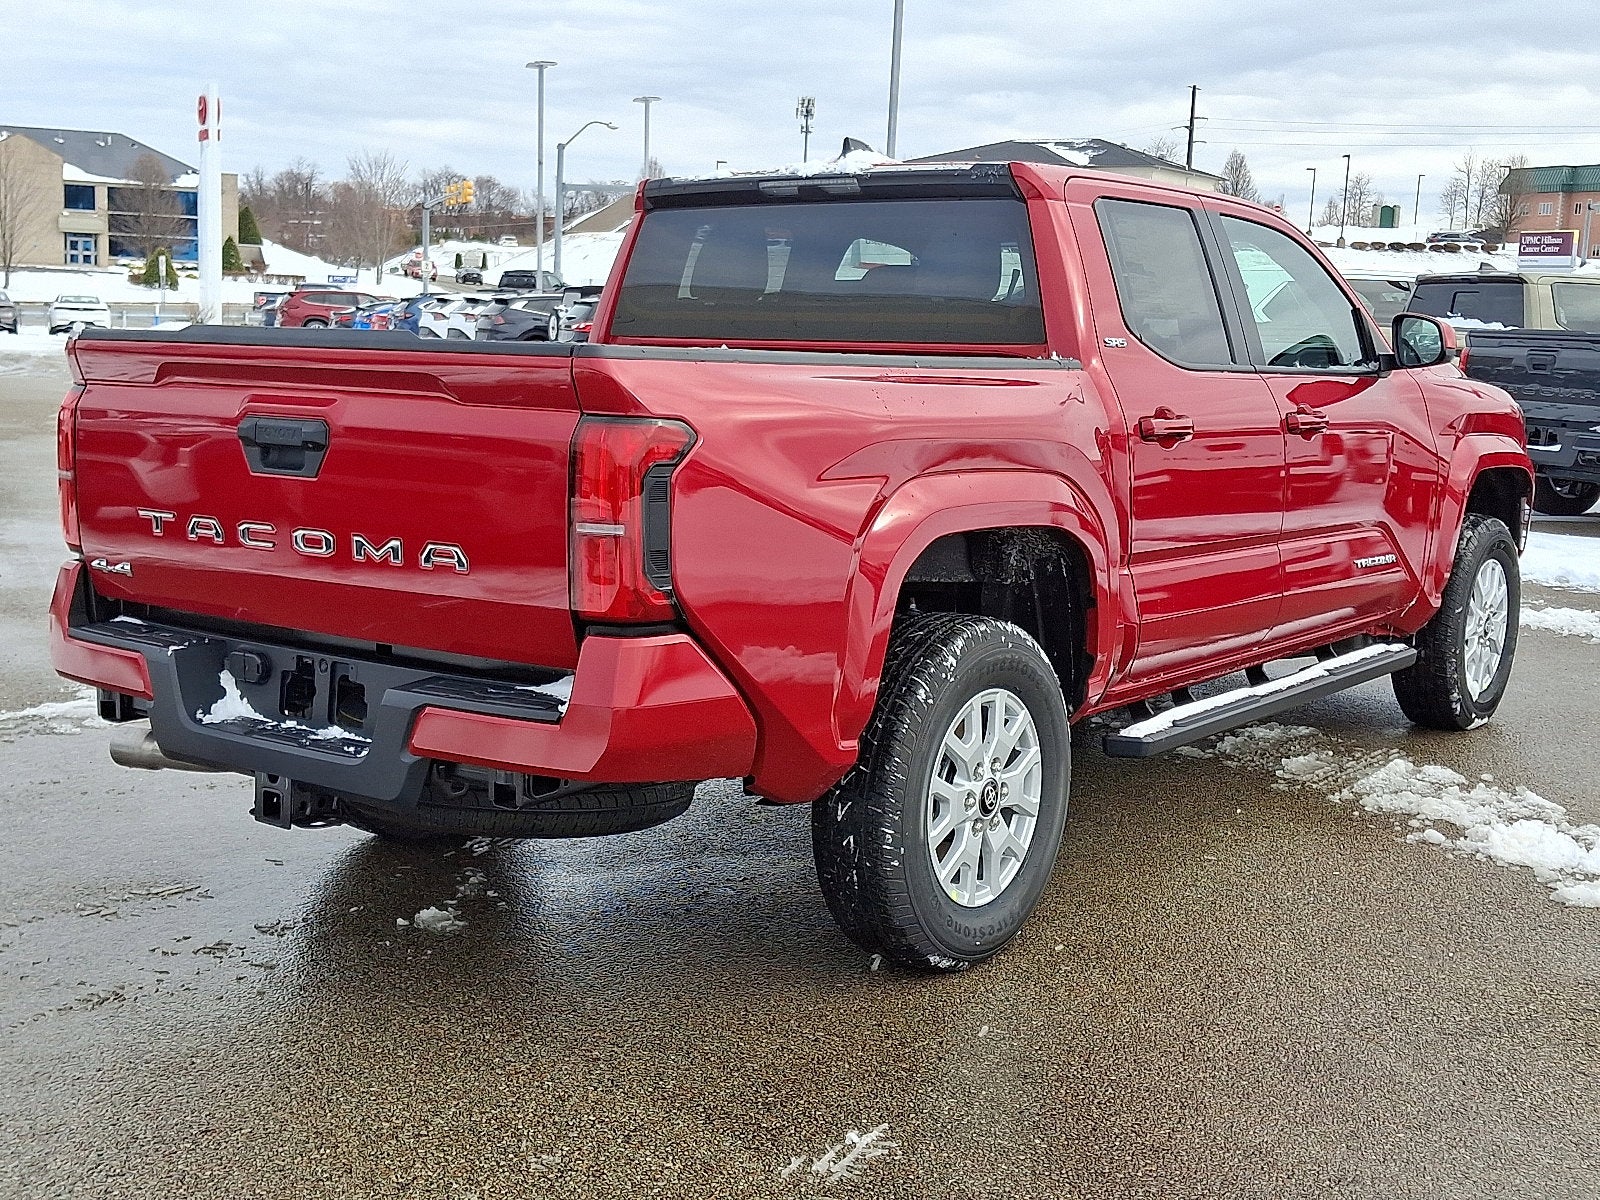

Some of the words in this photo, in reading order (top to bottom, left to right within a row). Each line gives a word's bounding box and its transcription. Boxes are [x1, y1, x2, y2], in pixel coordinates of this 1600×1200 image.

[1521, 235, 1541, 245] UPMC
[1541, 235, 1563, 244] Hillman
[1520, 244, 1540, 253] Cancer
[1540, 244, 1560, 253] Center
[1103, 337, 1128, 348] SR5
[1506, 383, 1596, 400] ACOMA
[137, 507, 470, 574] TACOMA
[1353, 553, 1398, 569] TACOMA
